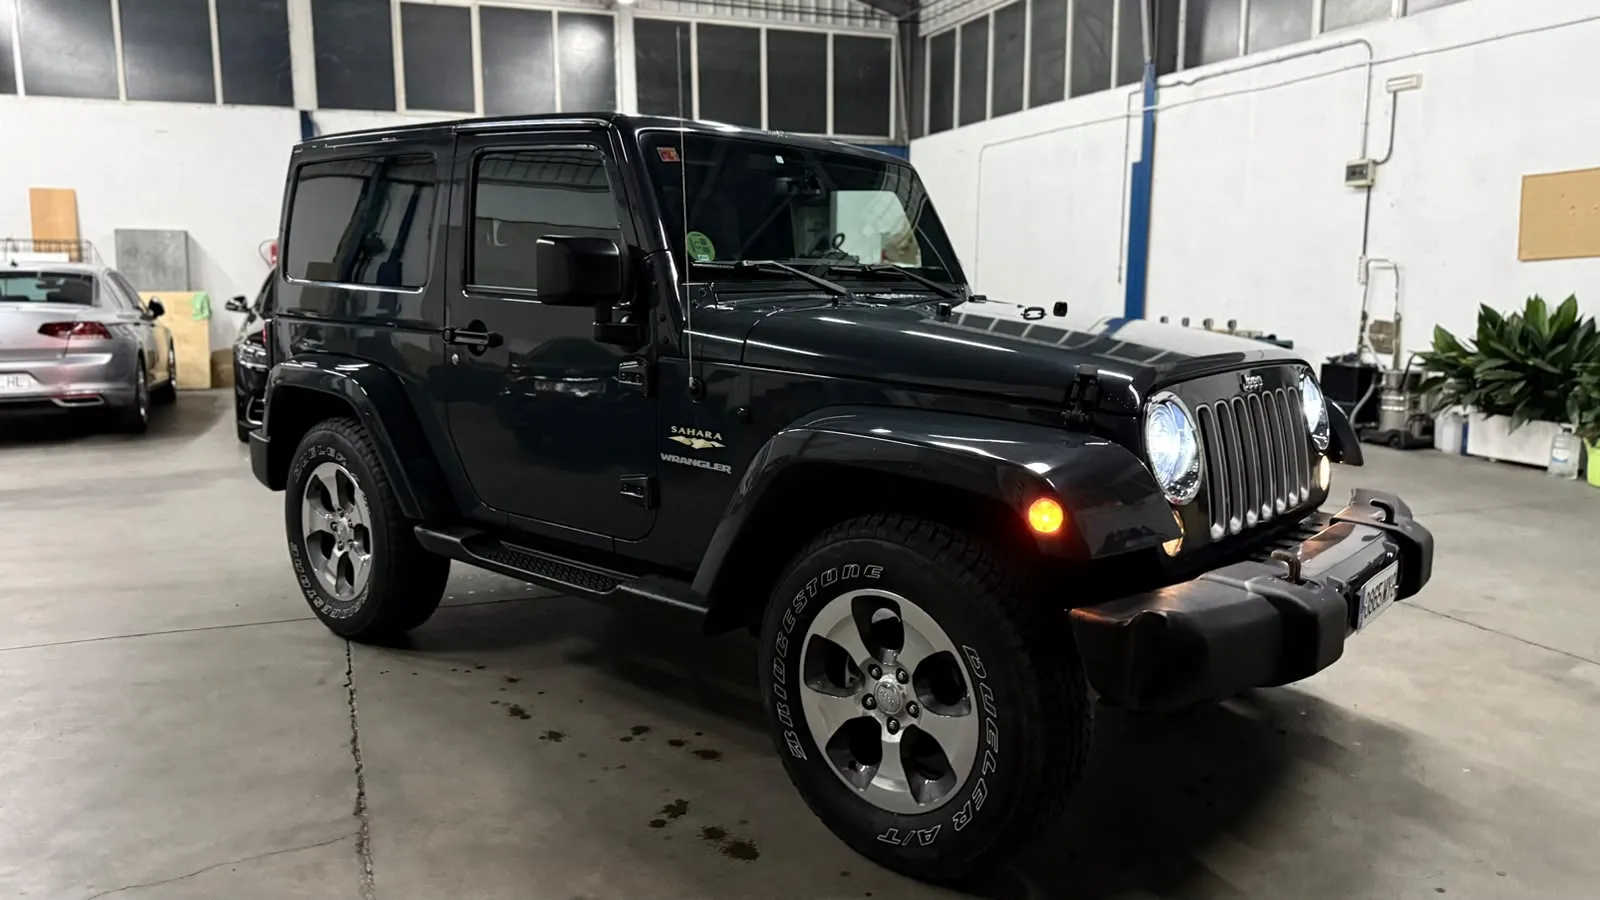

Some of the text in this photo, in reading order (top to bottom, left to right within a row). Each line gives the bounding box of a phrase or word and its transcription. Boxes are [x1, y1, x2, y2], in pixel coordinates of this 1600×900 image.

[660, 452, 732, 475] WRANGLER
[670, 425, 722, 441] SAHARA
[772, 563, 883, 760] BRIDGESTONE
[877, 644, 999, 846] DUELER A/T
